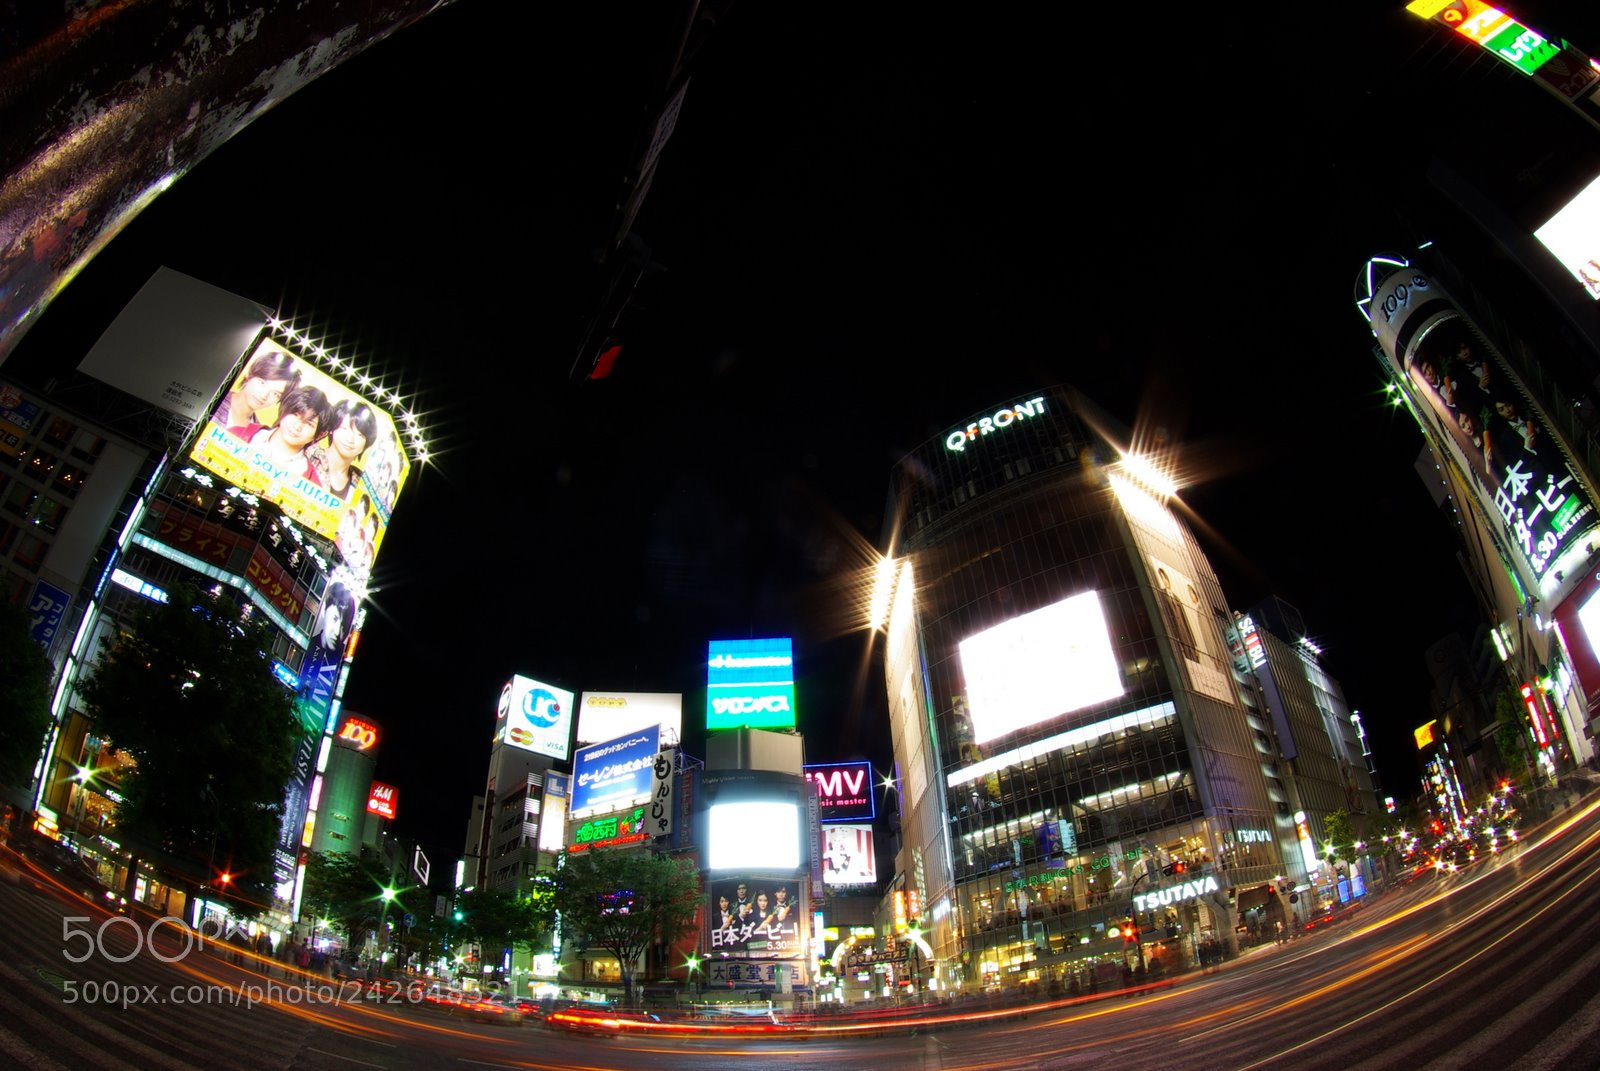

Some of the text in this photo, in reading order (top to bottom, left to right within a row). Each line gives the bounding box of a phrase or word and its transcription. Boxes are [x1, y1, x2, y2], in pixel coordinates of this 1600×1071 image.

[946, 396, 1045, 452] QFRONT
[210, 427, 249, 455] Hey!
[252, 453, 288, 478] Say!
[293, 480, 342, 508] JUMP
[1494, 459, 1533, 526] 日本
[1531, 531, 1558, 573] 5.30
[250, 558, 300, 616] コンタクト
[1236, 615, 1267, 670] SEIBU
[711, 695, 790, 714] サロンパス
[339, 721, 377, 750] 109
[547, 741, 565, 752] VISA
[373, 785, 394, 802] H&M
[651, 755, 671, 832] もんじゃ
[836, 797, 867, 806] master
[1004, 864, 1084, 894] STARBUCKS
[1132, 876, 1219, 912] TSUTAYA
[711, 921, 799, 948] 日本ダービー!
[767, 941, 787, 951] 5.30
